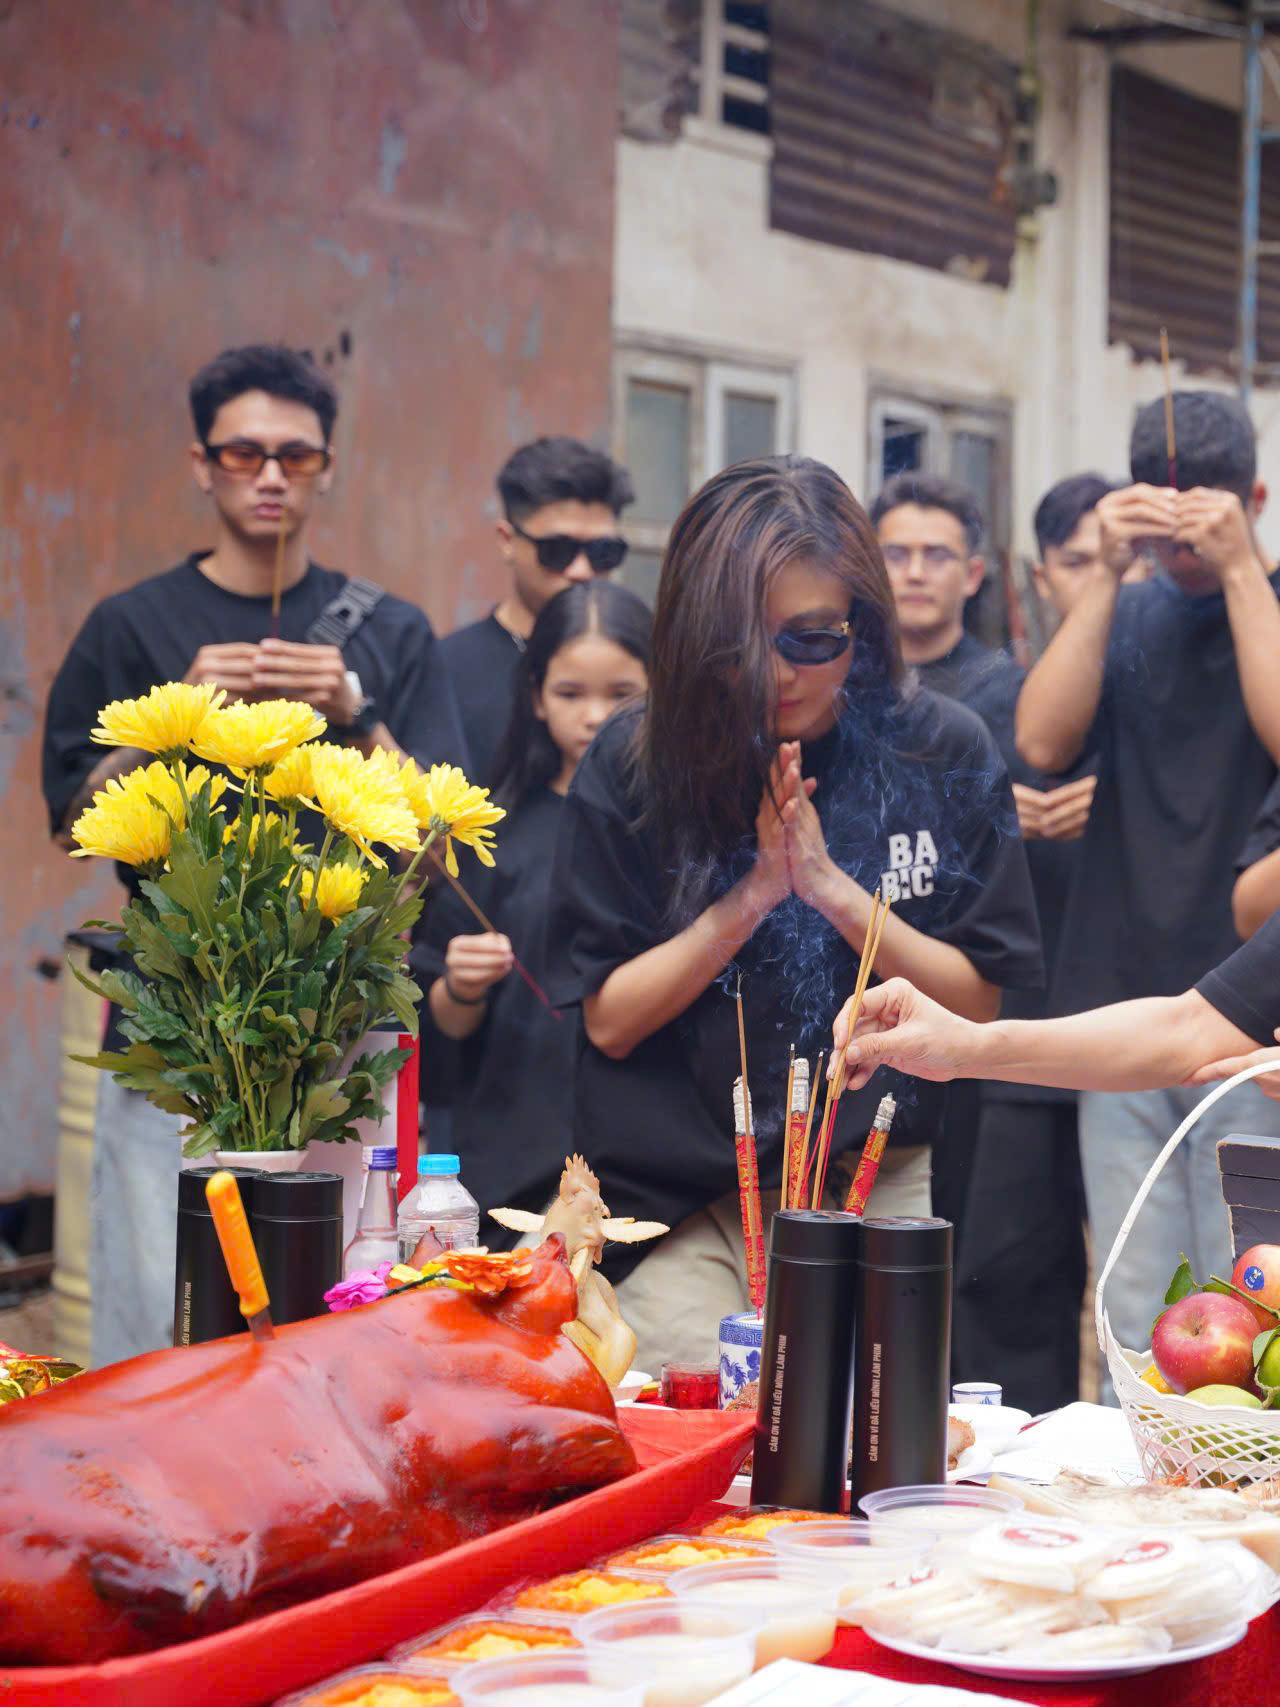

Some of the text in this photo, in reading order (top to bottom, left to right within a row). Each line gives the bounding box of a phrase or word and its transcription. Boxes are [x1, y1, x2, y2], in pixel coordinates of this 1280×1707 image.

[888, 829, 939, 870] BA
[778, 1334, 787, 1353] PHIM
[873, 1343, 881, 1361] PHIM
